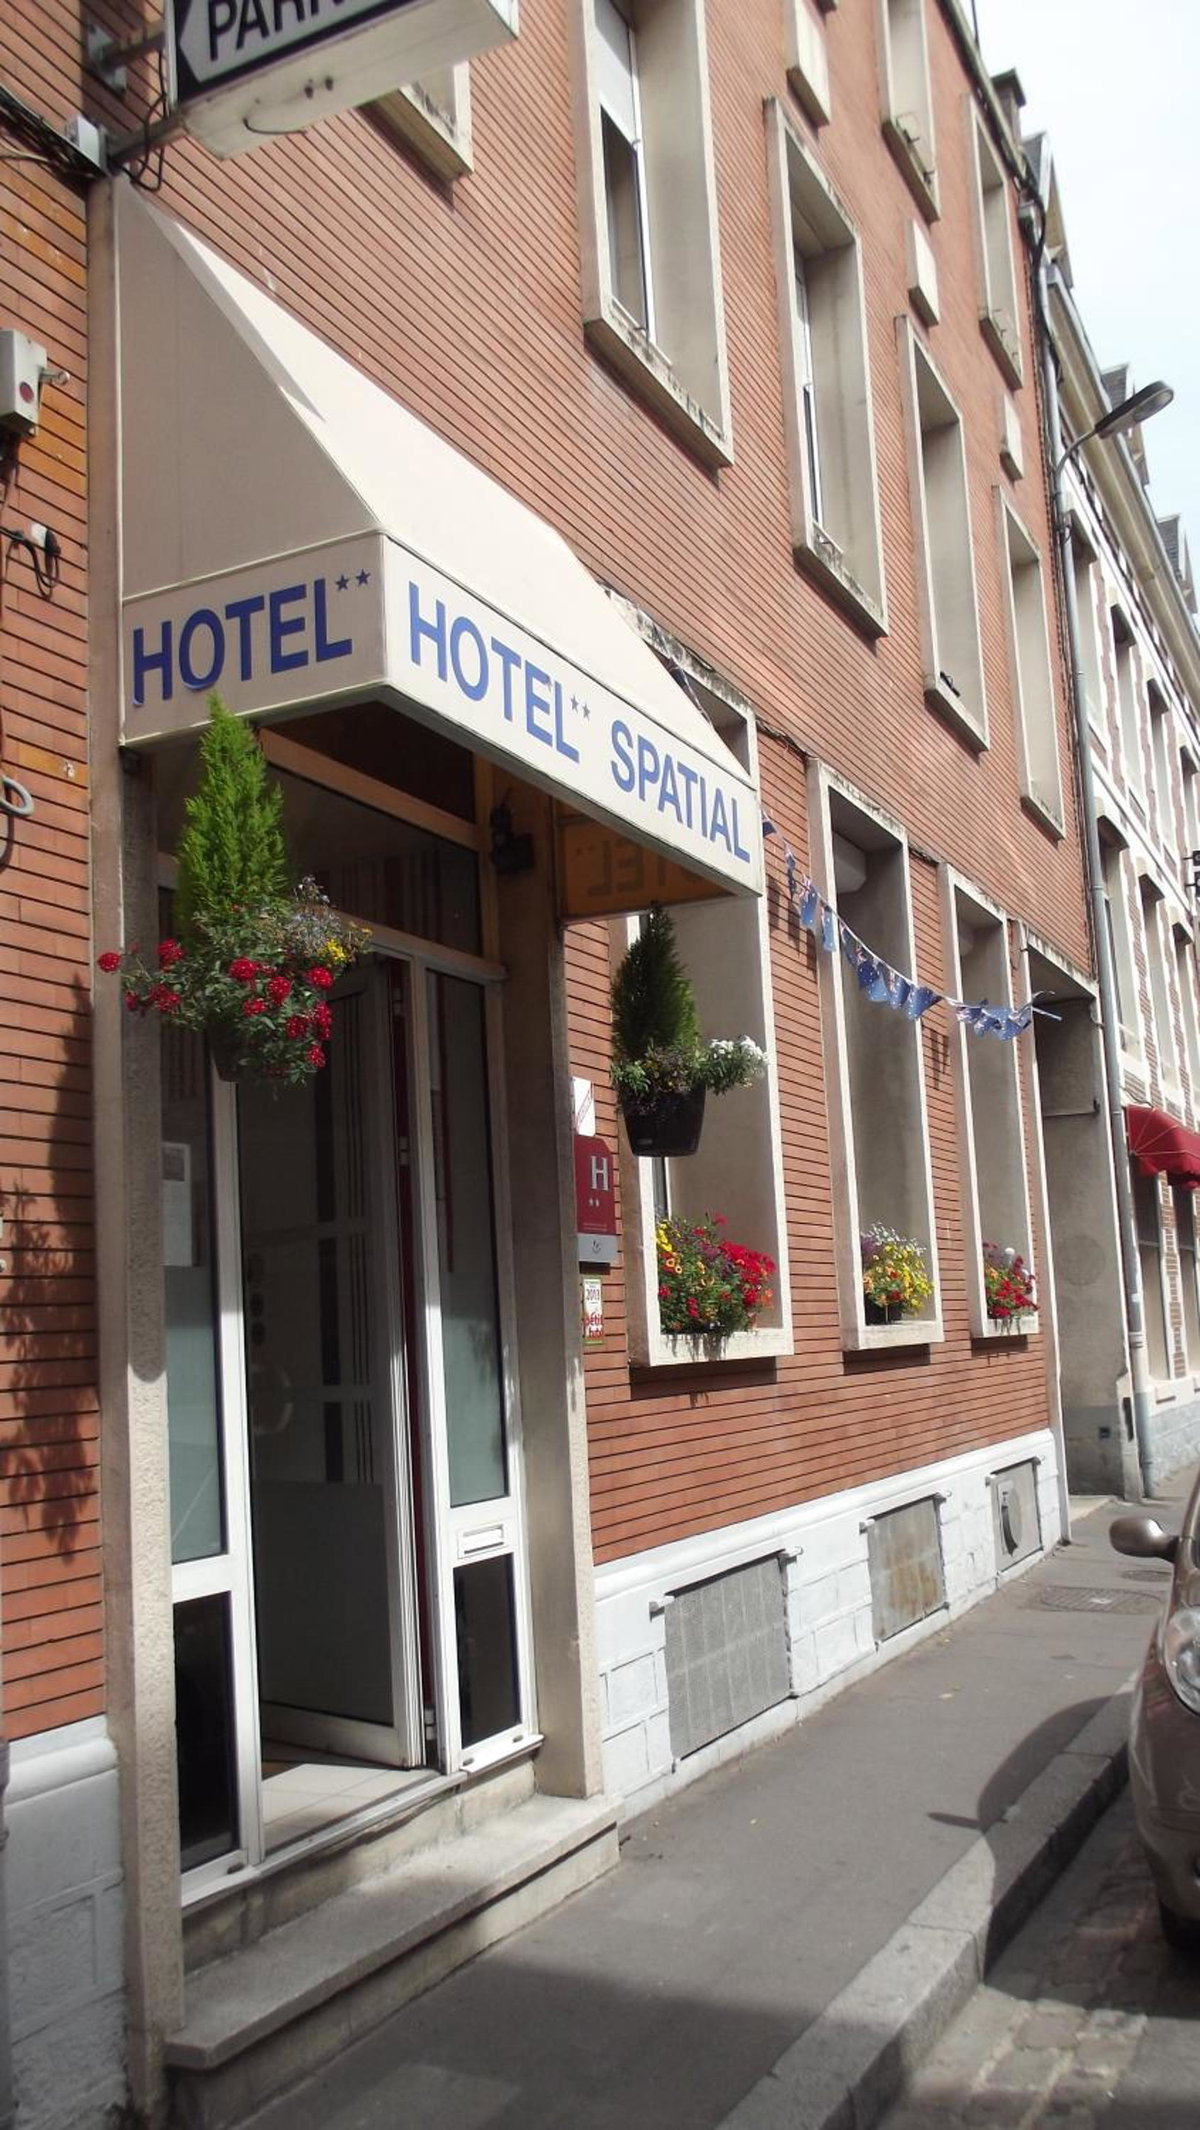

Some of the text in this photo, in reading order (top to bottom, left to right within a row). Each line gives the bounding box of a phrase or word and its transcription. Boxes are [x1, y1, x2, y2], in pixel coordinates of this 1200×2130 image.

[133, 578, 353, 706] HOTEL
[408, 580, 751, 864] HOTEL SPATIAL
[590, 1155, 609, 1192] H
